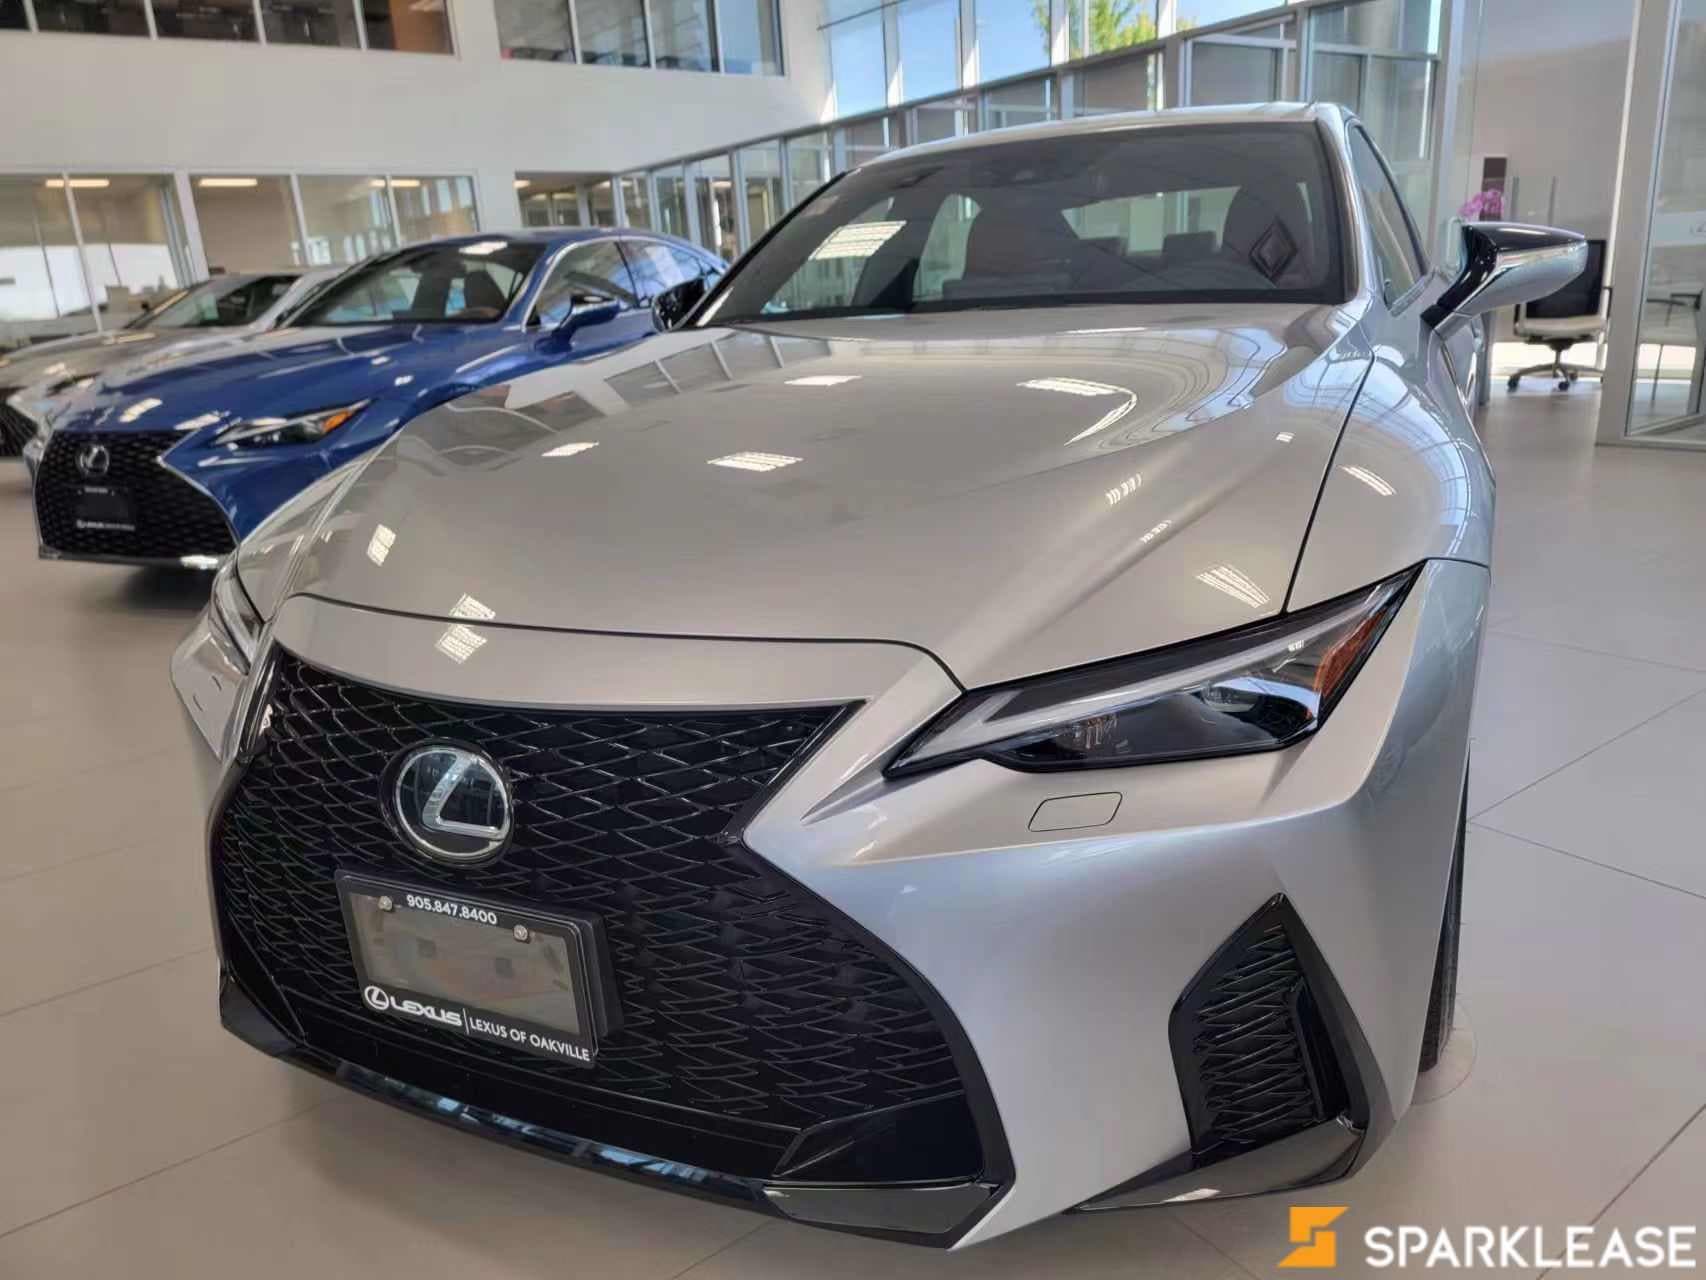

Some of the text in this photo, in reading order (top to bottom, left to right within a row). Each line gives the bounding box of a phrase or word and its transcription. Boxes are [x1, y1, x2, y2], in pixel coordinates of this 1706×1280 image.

[406, 894, 498, 925] 905.847.8400
[390, 996, 463, 1027] LEXUS
[469, 1018, 591, 1062] LEXUS OF OAKVILLE
